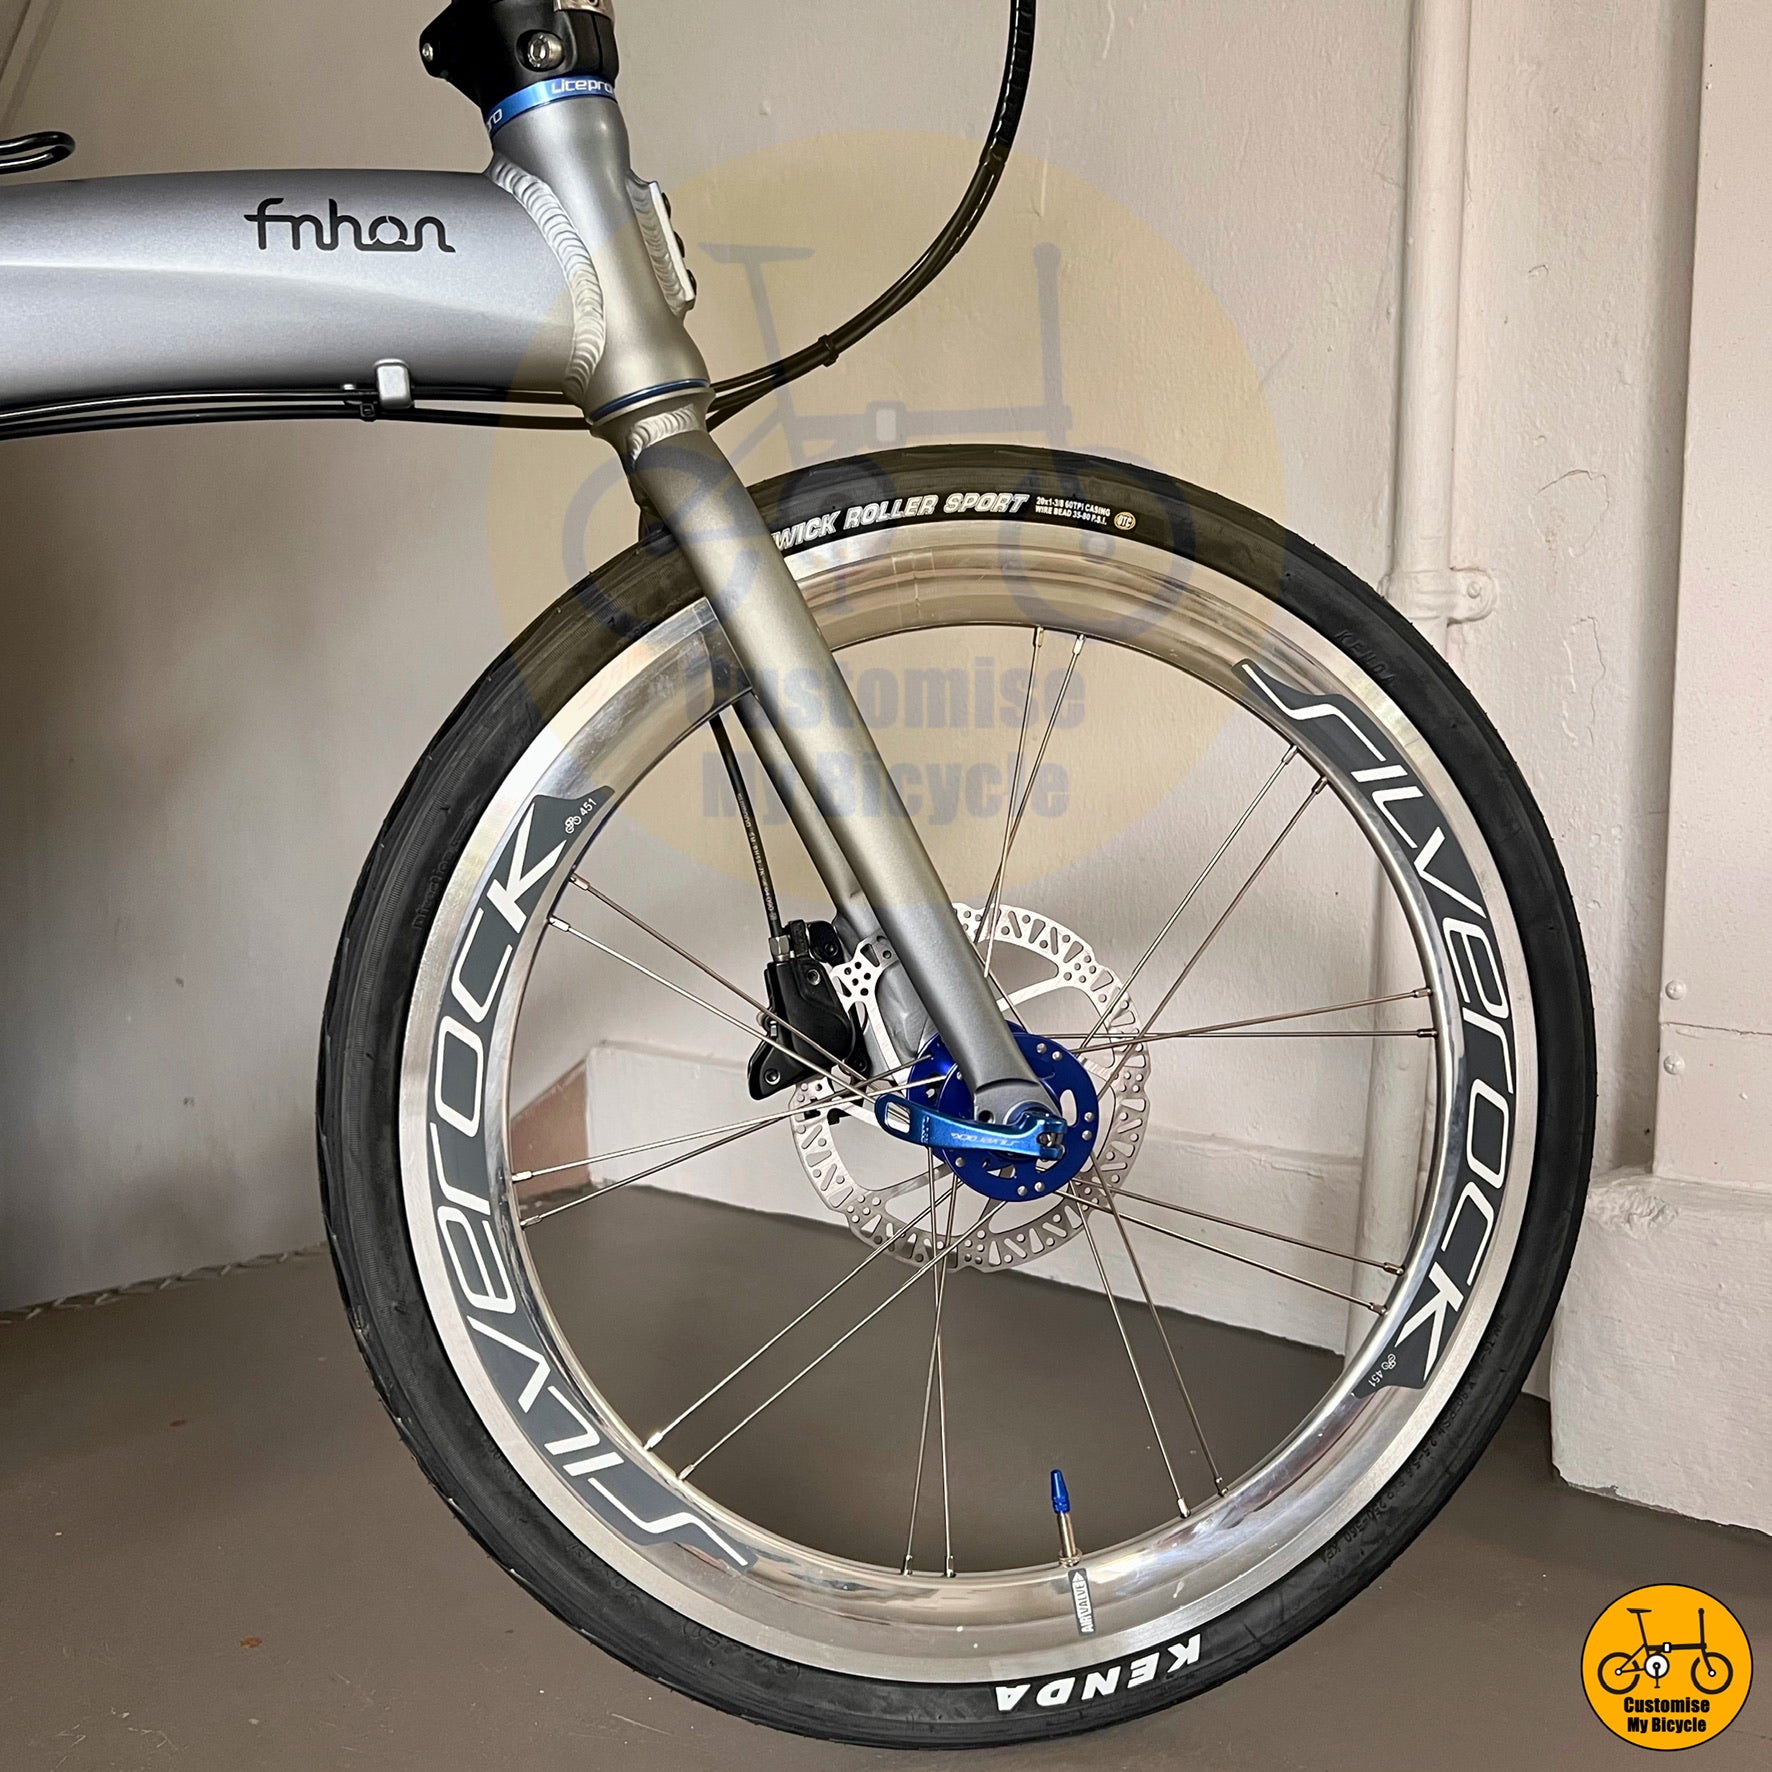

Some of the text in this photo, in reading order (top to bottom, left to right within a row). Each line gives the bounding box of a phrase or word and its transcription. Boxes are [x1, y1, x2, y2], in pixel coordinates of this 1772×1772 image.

[244, 198, 456, 252] fnhon
[843, 494, 939, 530] ROLLER
[943, 492, 1029, 514] SPORT
[1035, 505, 1053, 515] WIRE
[1053, 507, 1072, 517] BEAD
[1085, 504, 1111, 517] CASING
[580, 798, 597, 816] 451
[1368, 1370, 1383, 1387] 451
[995, 1633, 1201, 1712] KENDA
